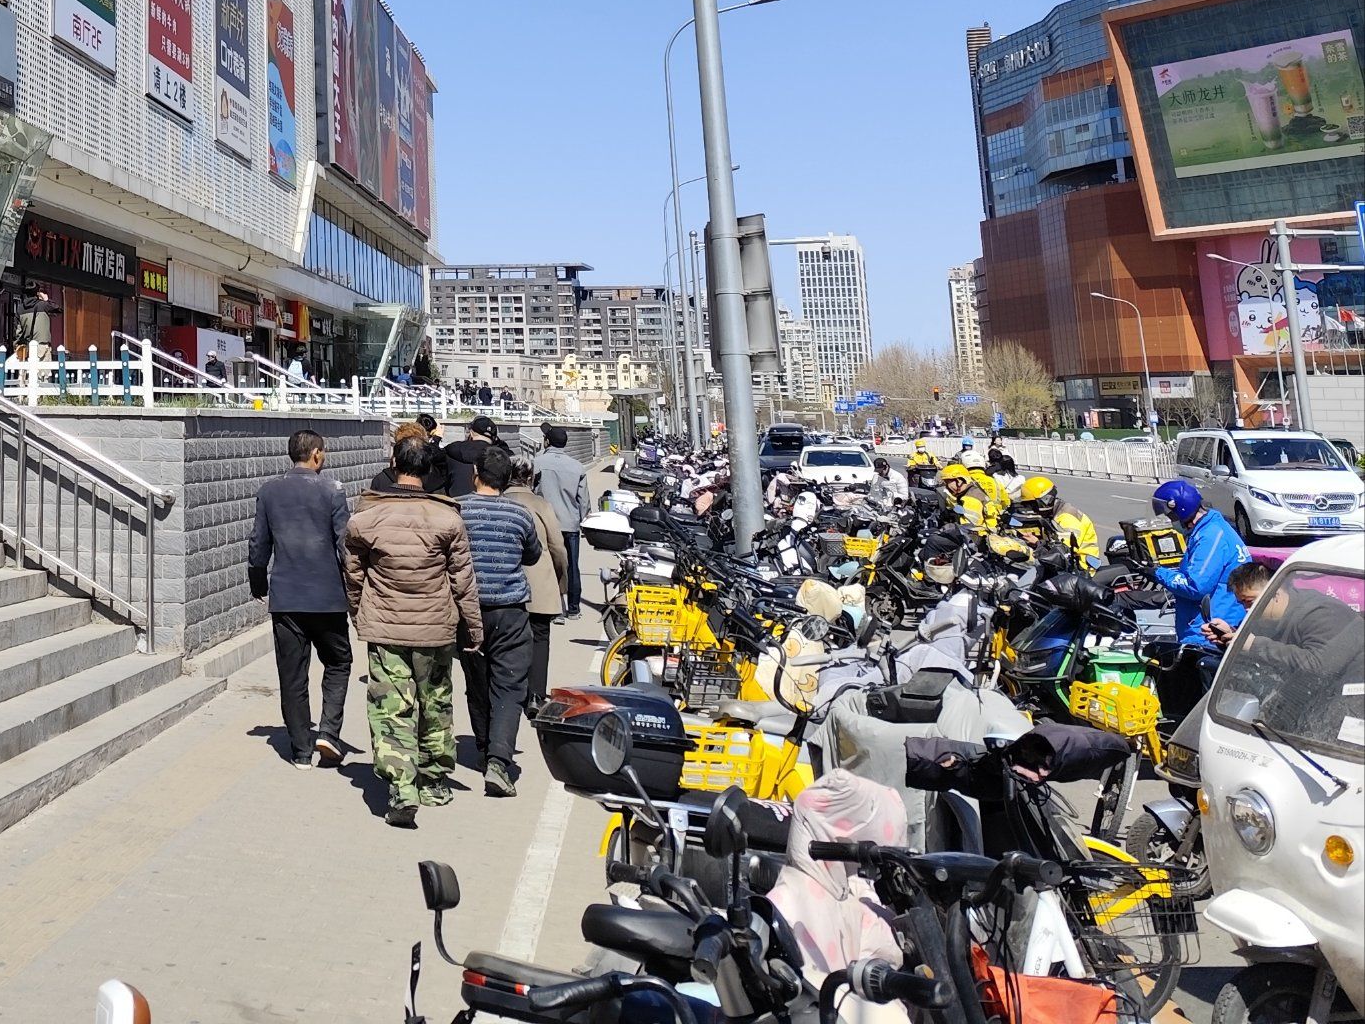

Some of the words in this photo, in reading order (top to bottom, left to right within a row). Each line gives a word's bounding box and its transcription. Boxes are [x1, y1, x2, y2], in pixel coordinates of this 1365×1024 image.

[1168, 84, 1225, 108] 大师龙井
[82, 241, 126, 282] 木炭烤肉
